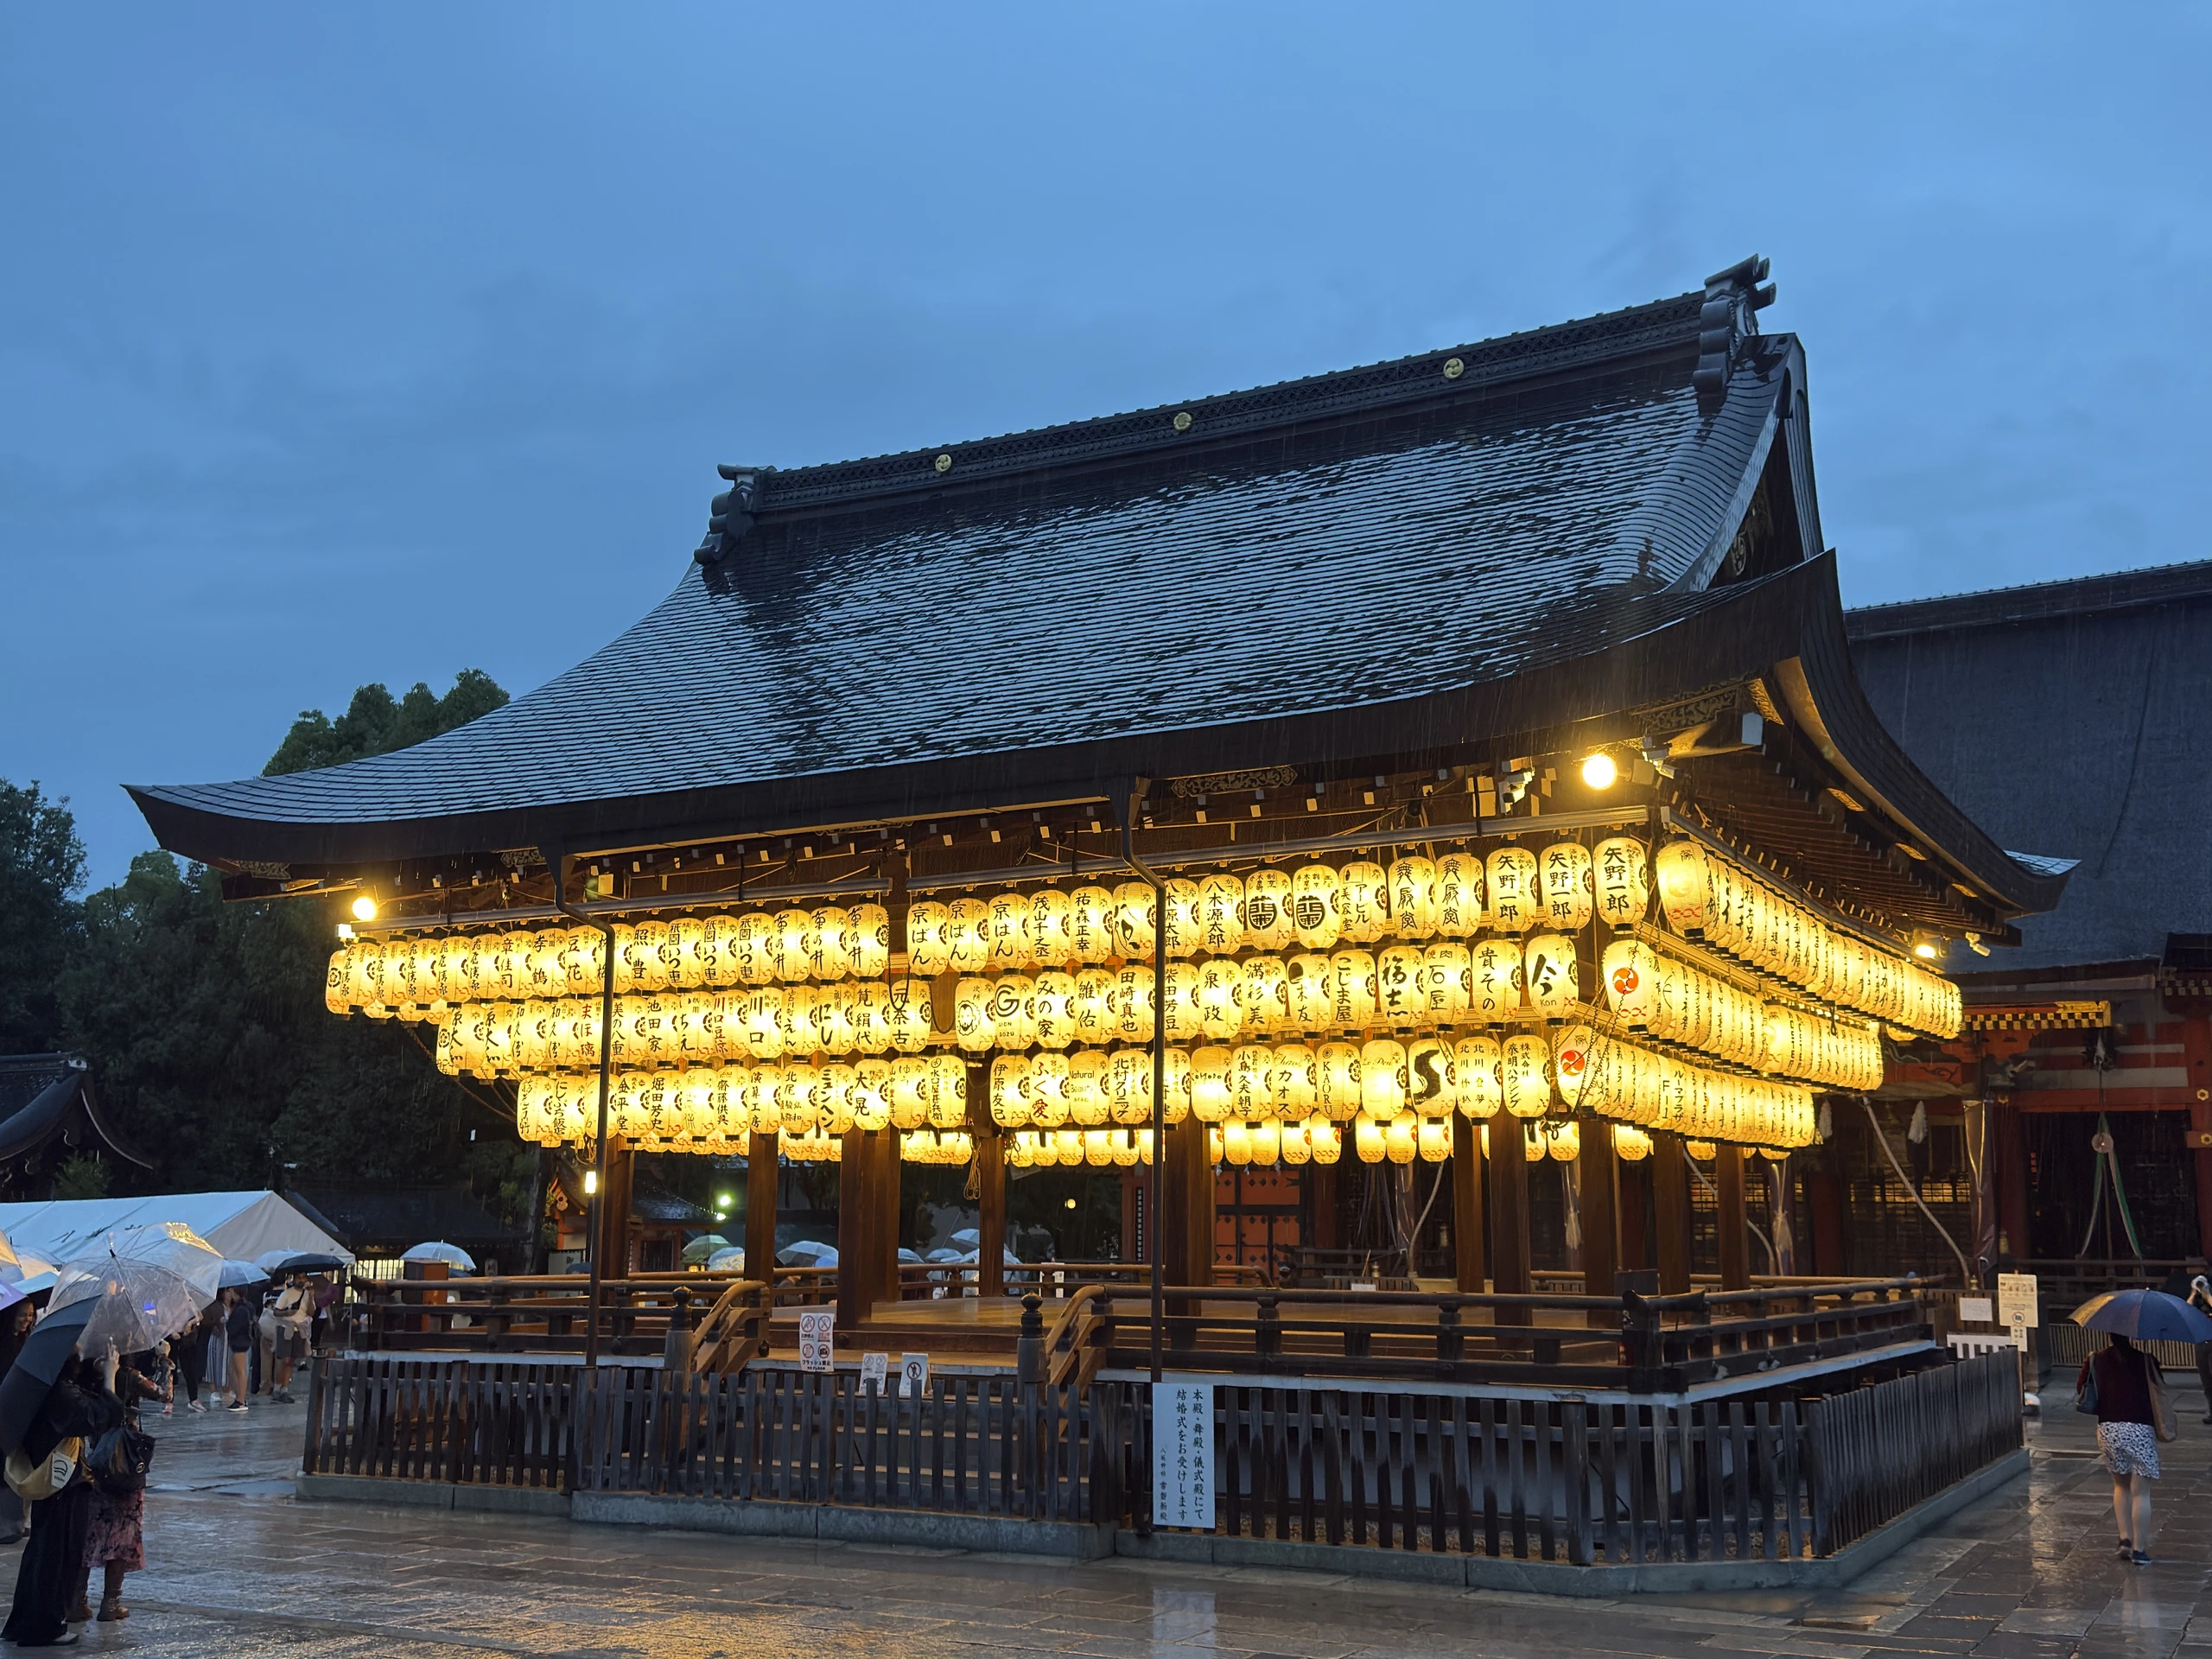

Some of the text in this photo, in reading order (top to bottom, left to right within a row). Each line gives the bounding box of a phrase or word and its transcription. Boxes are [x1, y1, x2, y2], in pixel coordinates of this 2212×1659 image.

[1497, 854, 1519, 923] 矢野一郎
[1548, 851, 1573, 920] 矢野一郎
[1603, 847, 1630, 916] 矢野一郎
[912, 906, 931, 965] 京ばん
[950, 901, 969, 961] 京ばん
[1205, 880, 1225, 949] 八木源太郎
[567, 935, 582, 982] 豆花
[1478, 947, 1498, 1012] 貴その
[1037, 980, 1056, 1039] みの家
[1119, 971, 1139, 1033] 田崎真也
[1204, 969, 1224, 1022] 泉政
[1336, 957, 1355, 1022] こじま屋
[1540, 998, 1557, 1007] Kon
[611, 1001, 626, 1056] 美の八重
[648, 1000, 663, 1053] 池田家
[748, 995, 765, 1045] 川口
[617, 1077, 631, 1131] 金平堂
[650, 1077, 665, 1131] 堀田芳史
[785, 1071, 798, 1096] 北尾
[820, 1068, 835, 1128] ミュンヘン
[1032, 1061, 1050, 1120] ふく愛
[1070, 1071, 1095, 1079] Natural
[1113, 1058, 1130, 1118] 北村クリニック
[1278, 1070, 1294, 1115] カオス
[1323, 1061, 1334, 1116] KAORU
[553, 1081, 569, 1135] にしぶち飯店
[1176, 1389, 1188, 1522] 結婚式をお受けします
[1192, 1388, 1205, 1521] 本殿・舞殿・儀式殿にて
